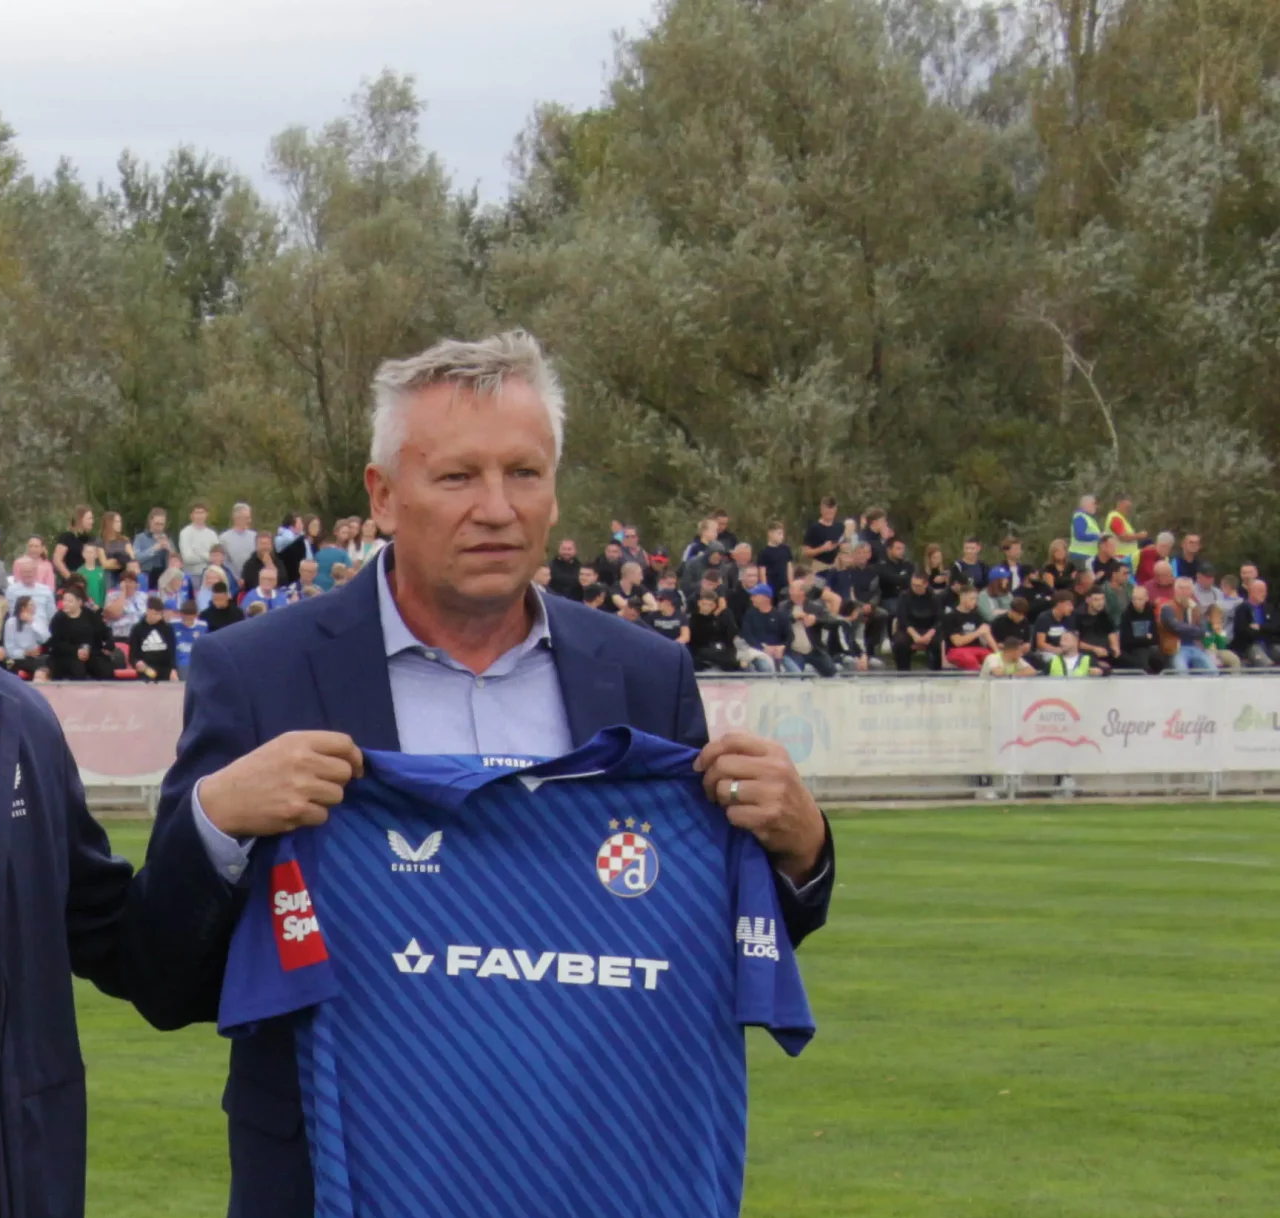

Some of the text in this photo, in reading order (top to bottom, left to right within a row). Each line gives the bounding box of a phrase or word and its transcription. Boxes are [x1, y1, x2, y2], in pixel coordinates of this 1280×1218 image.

[1101, 707, 1218, 748] Super Lucija
[391, 862, 441, 873] CASTORE
[446, 944, 669, 990] FAVBET
